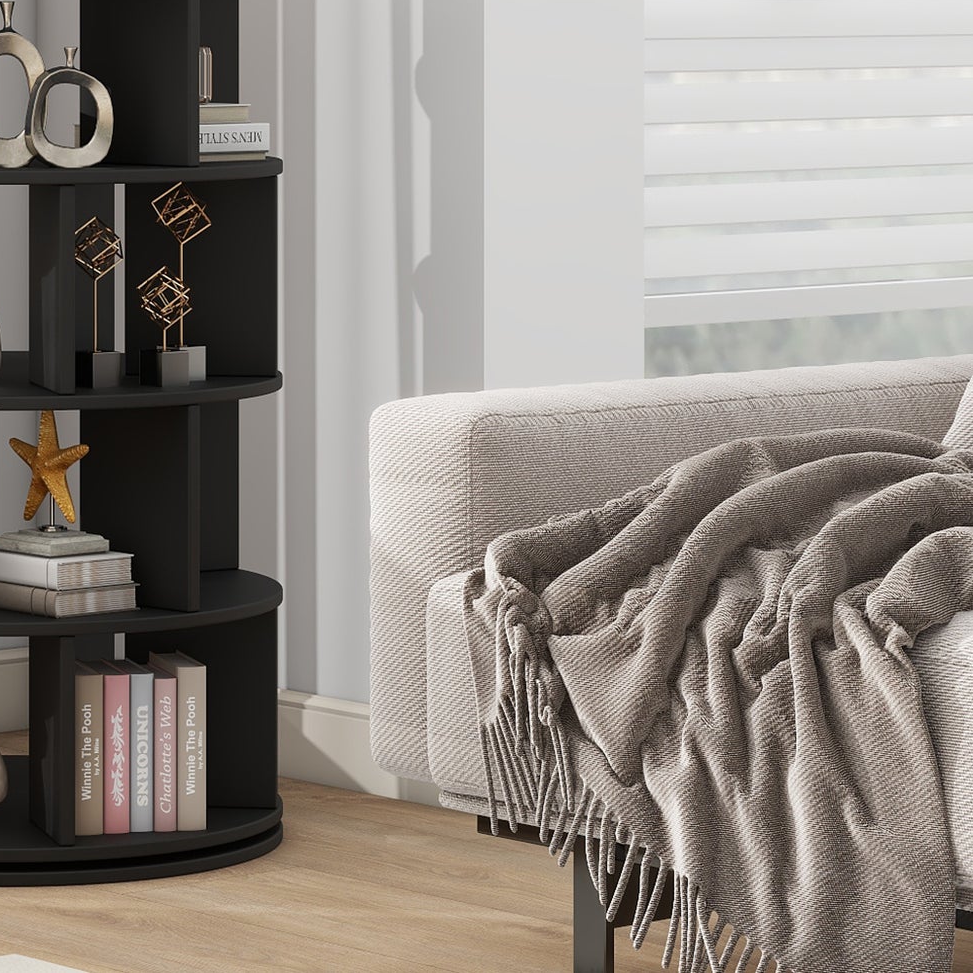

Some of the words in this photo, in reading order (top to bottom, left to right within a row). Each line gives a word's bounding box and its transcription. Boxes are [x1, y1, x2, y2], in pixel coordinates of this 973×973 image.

[232, 131, 262, 143] MEN'S
[81, 704, 92, 734] Pooh
[160, 696, 172, 727] Web
[186, 696, 196, 727] Pooh
[81, 737, 92, 758] The
[136, 705, 148, 806] UNICORNS
[186, 730, 196, 752] The
[81, 761, 92, 801] Winnie
[186, 755, 196, 795] Winnie
